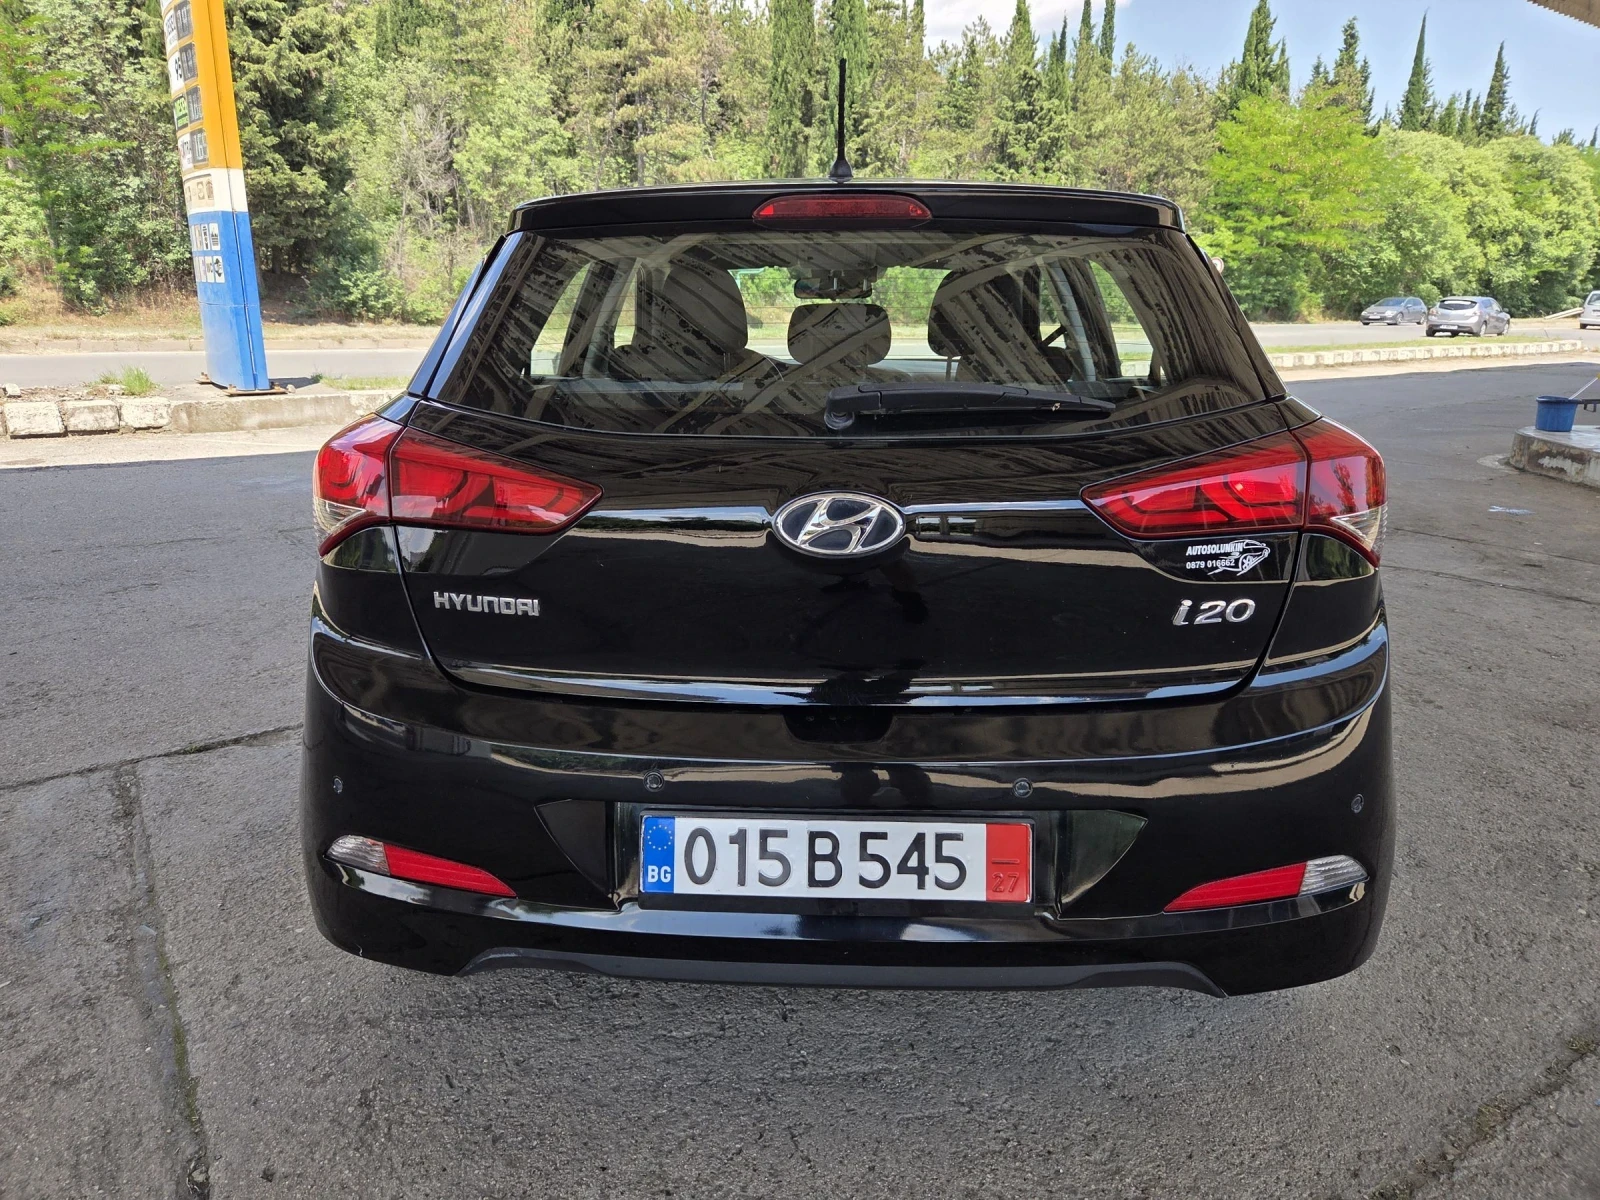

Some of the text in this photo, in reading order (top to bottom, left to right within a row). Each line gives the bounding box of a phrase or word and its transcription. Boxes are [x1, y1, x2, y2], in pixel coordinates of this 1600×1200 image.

[1186, 561, 1205, 569] 0879
[433, 591, 540, 617] HYUNDAI
[1172, 598, 1256, 626] i20
[647, 865, 672, 883] BG
[992, 872, 1019, 893] 27
